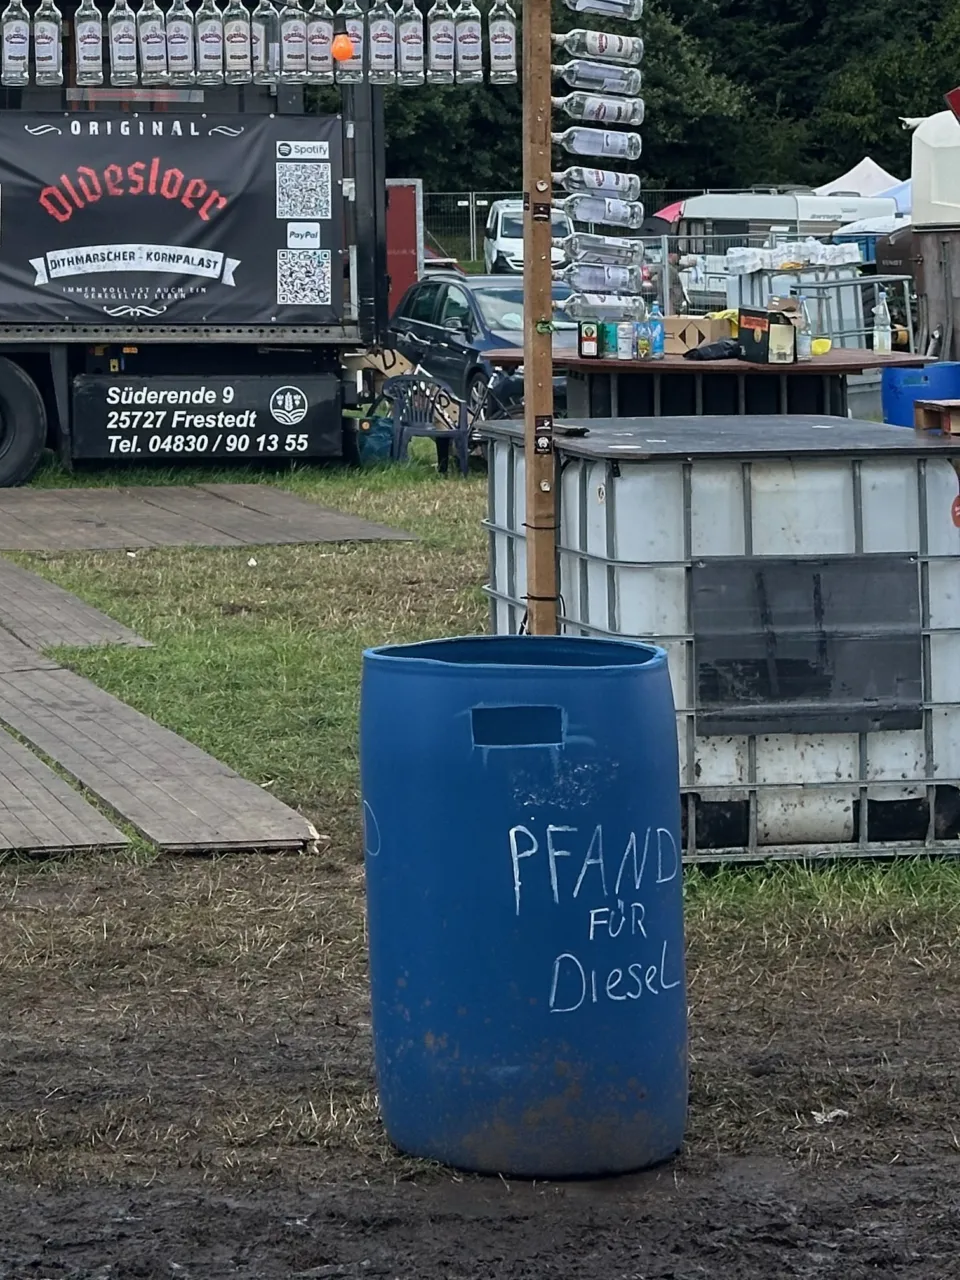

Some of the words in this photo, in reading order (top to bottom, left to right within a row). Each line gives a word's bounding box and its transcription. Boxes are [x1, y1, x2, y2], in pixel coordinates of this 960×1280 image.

[70, 120, 200, 136] ORIGINAL
[293, 144, 328, 156] Spotify
[289, 230, 318, 241] PayPal
[49, 250, 136, 271] DITHMARSCHER
[146, 251, 219, 270] KORNPALAST
[106, 386, 217, 405] Süderende
[222, 386, 235, 404] 9
[106, 411, 166, 429] 25727
[171, 410, 257, 428] Frestedt
[108, 435, 142, 453] Tel.
[148, 435, 209, 452] 04830
[225, 435, 250, 452] 90
[256, 434, 279, 452] 13
[284, 434, 309, 451] 55
[508, 823, 679, 917] PFAND
[589, 898, 648, 941] FÜR
